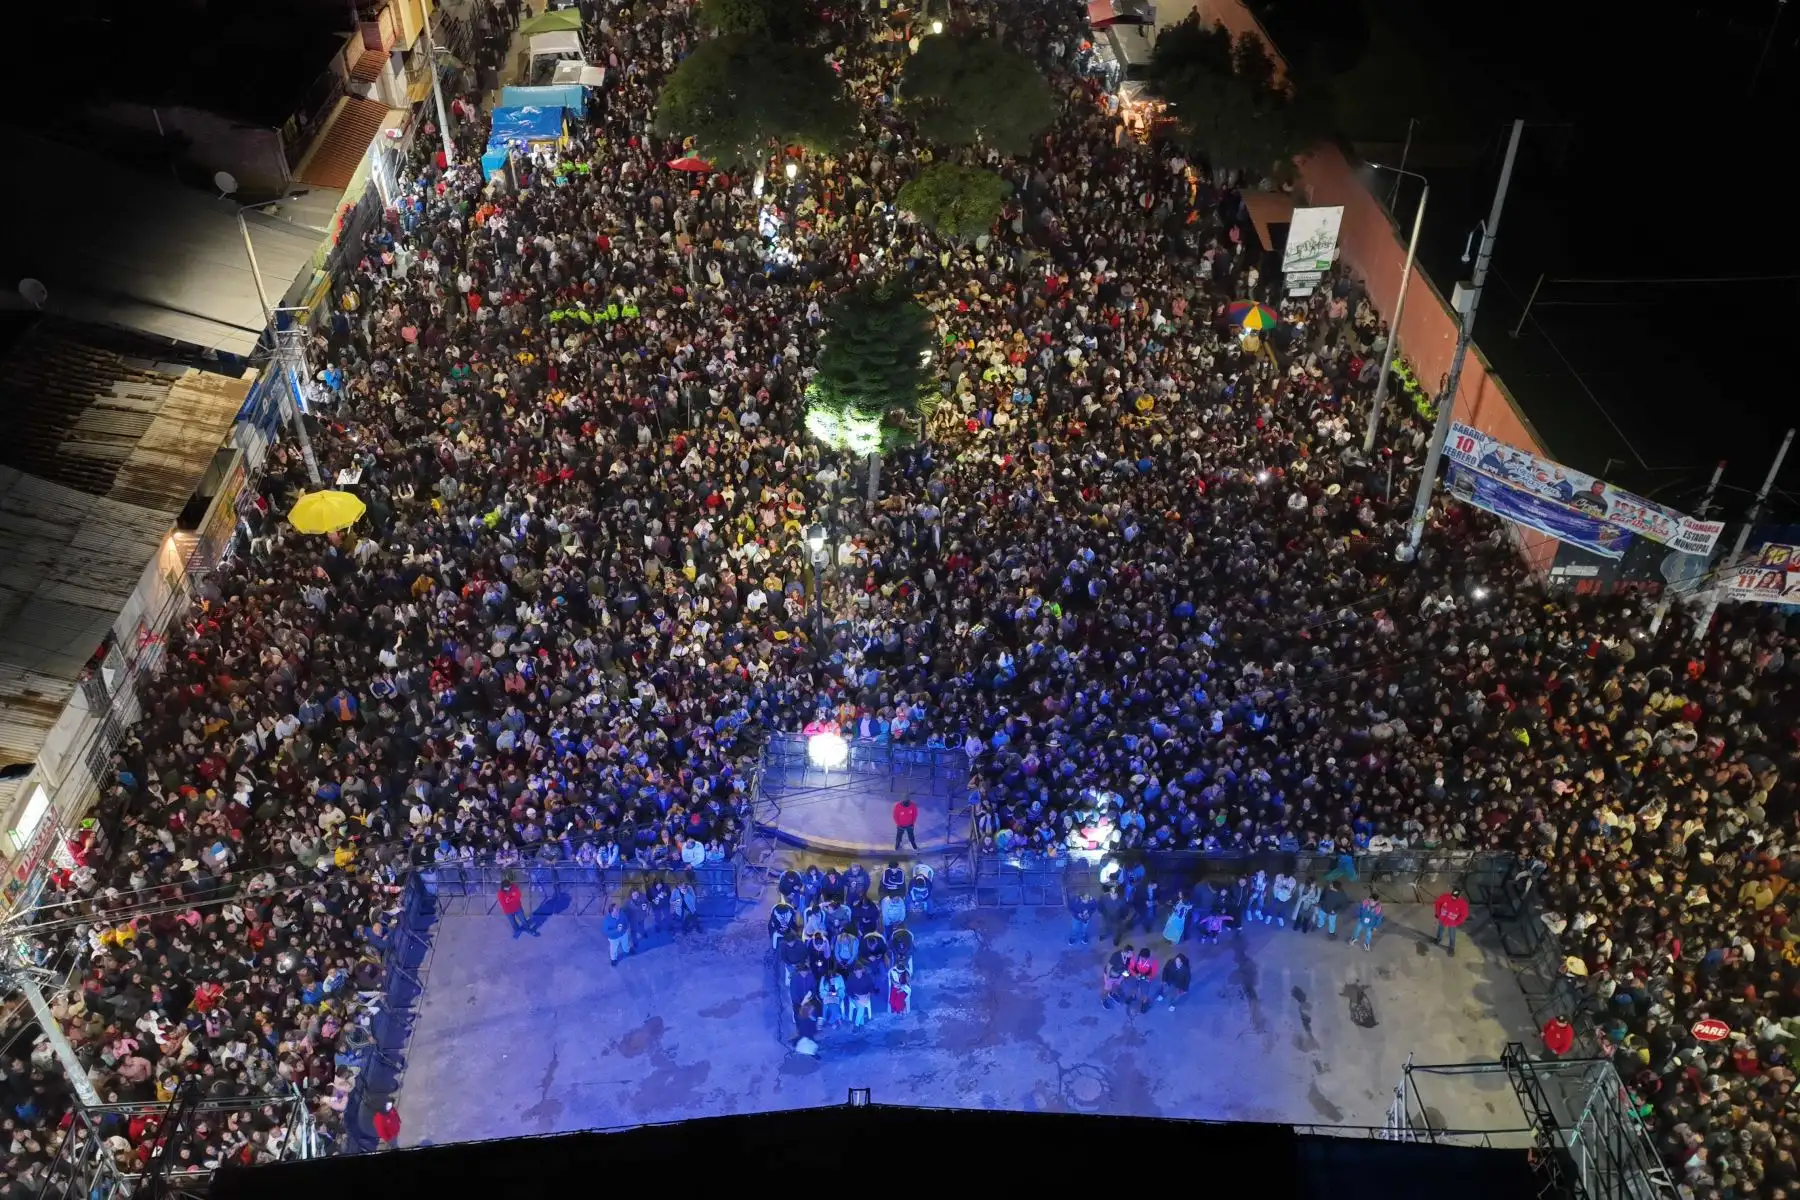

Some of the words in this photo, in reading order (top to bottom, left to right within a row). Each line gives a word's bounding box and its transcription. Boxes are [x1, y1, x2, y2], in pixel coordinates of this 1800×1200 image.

[1455, 435, 1475, 453] 10
[1443, 445, 1478, 465] FEBRERO
[1683, 519, 1720, 533] CAJAMARCA
[1683, 530, 1711, 543] ESTADIO
[1673, 537, 1710, 554] MUNICIPAL
[1736, 575, 1756, 588] 11
[1694, 1023, 1727, 1037] PARE
